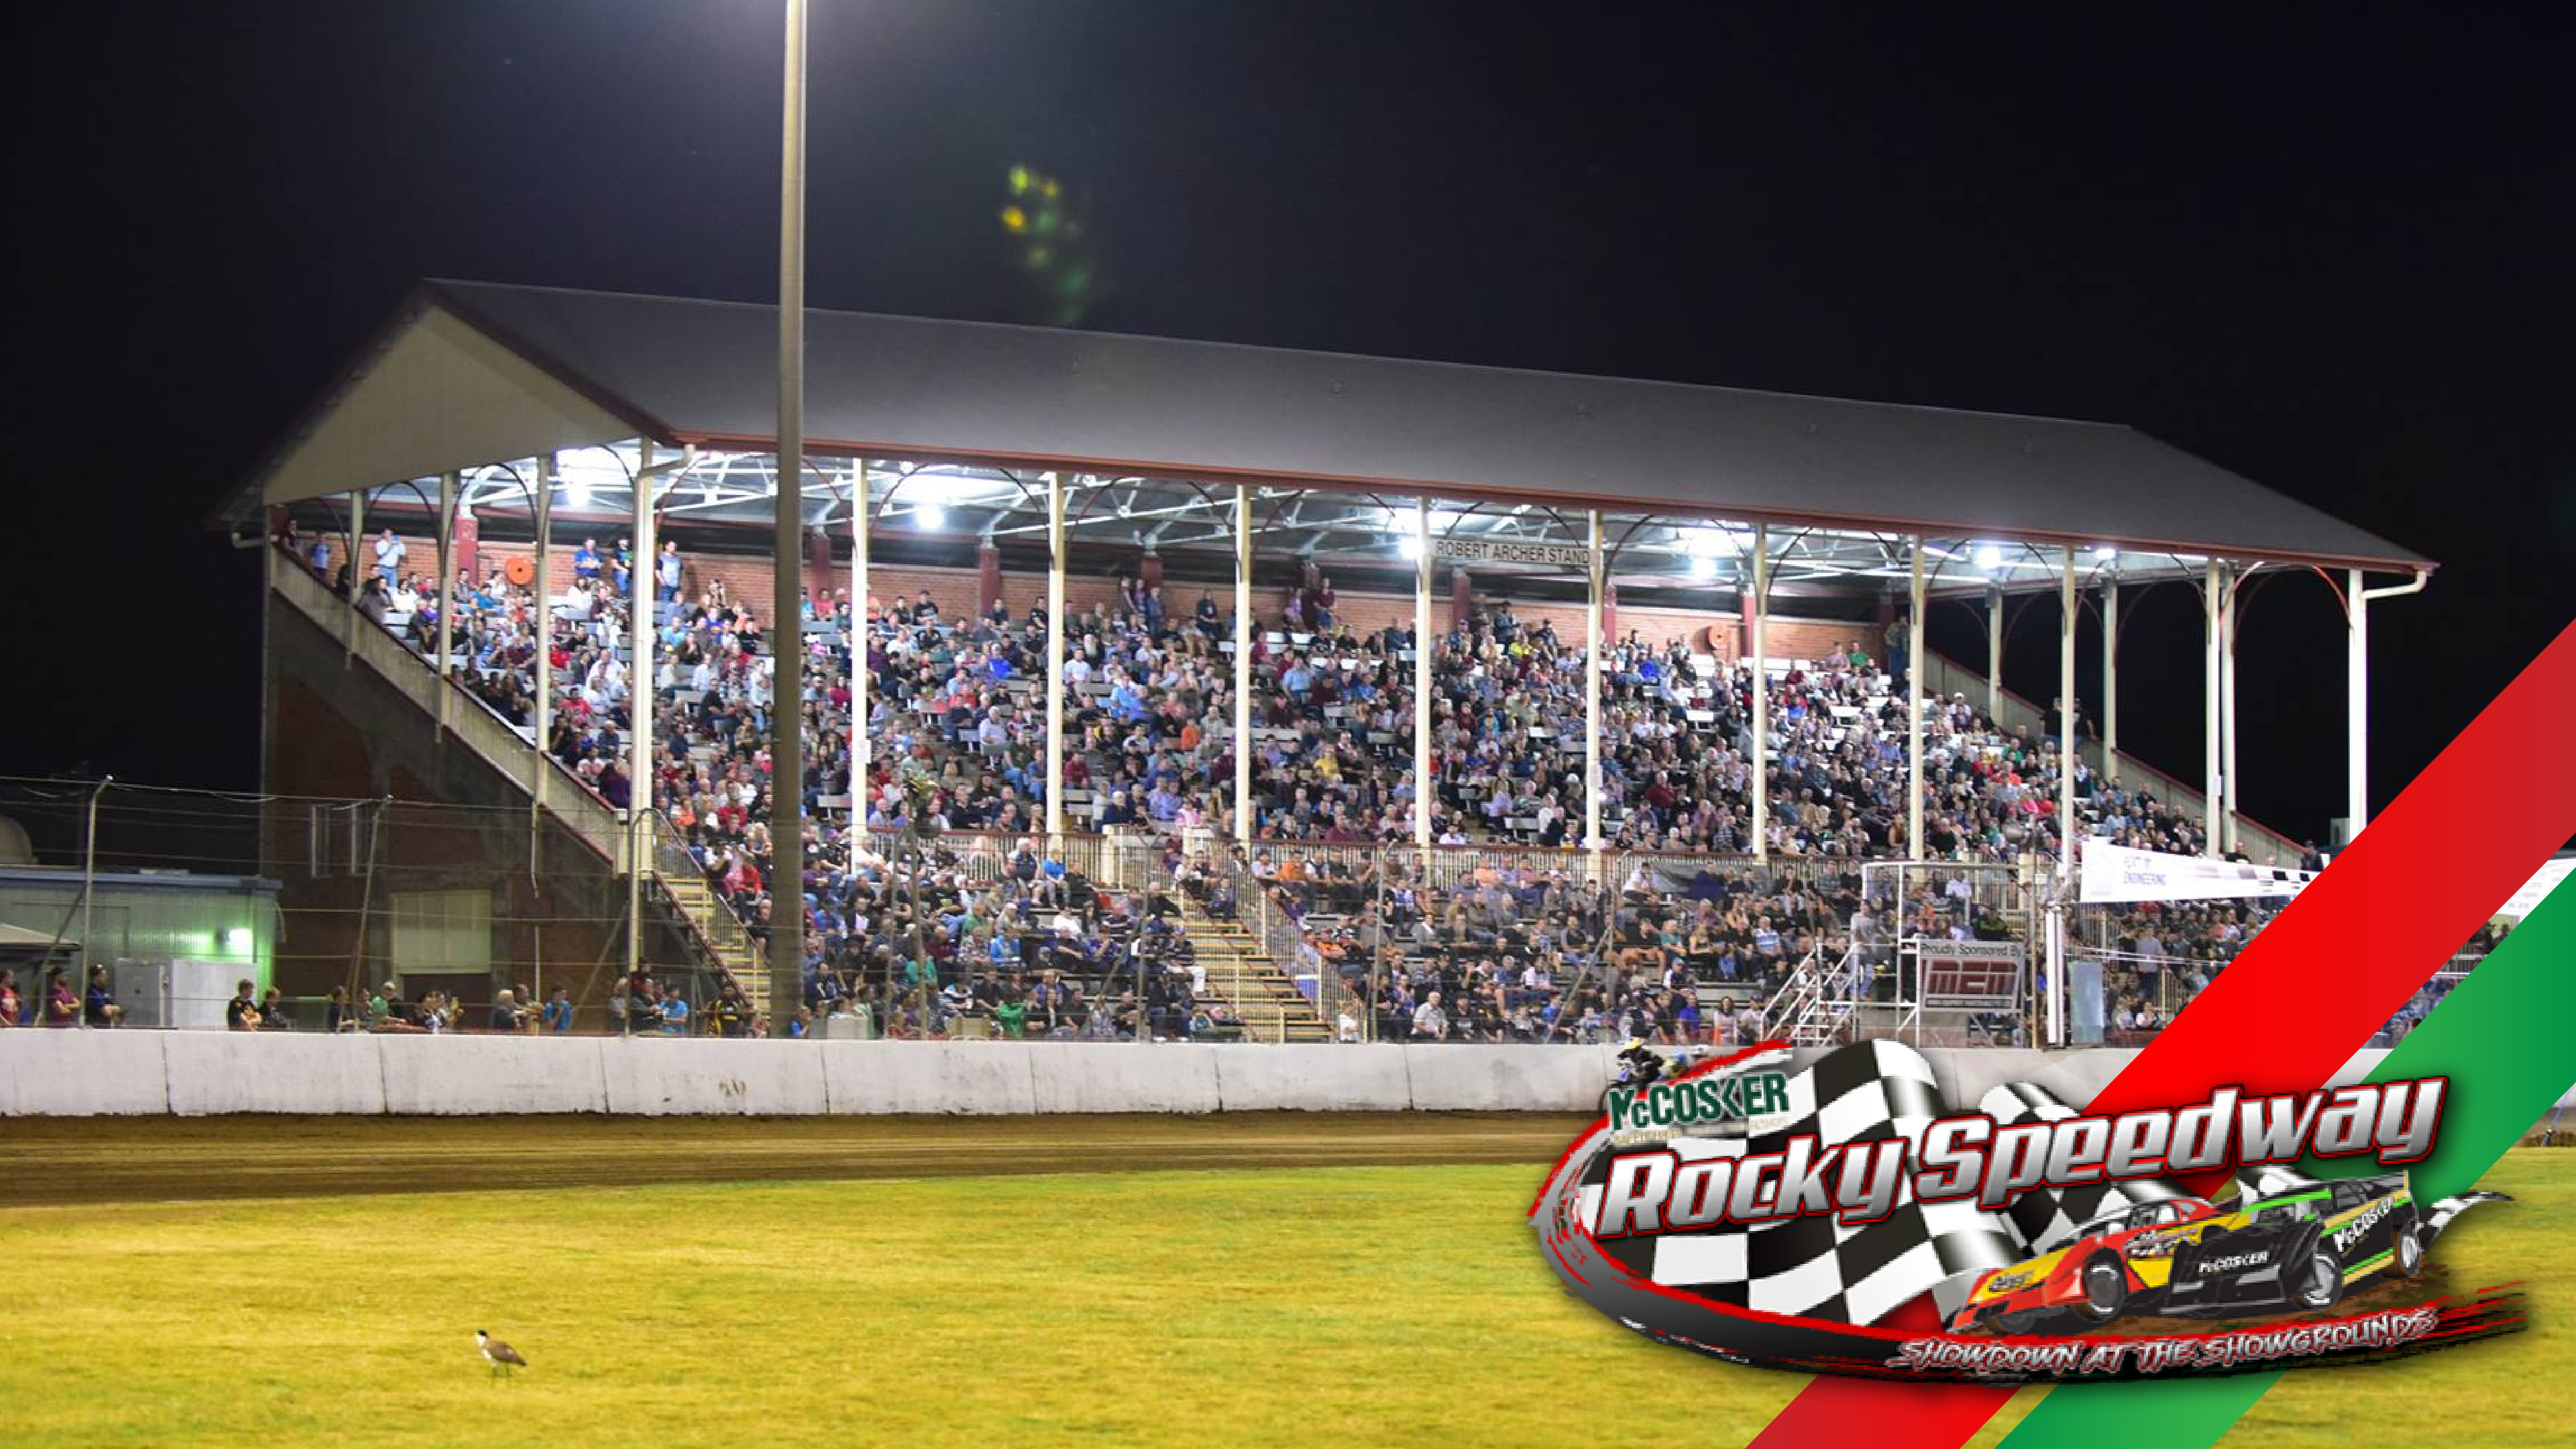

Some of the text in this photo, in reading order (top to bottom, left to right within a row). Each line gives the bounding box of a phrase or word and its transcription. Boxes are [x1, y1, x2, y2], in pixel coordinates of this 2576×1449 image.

[1436, 541, 1589, 564] ROBERT ARCHER STAND
[1921, 943, 1955, 956] Proudly
[1958, 943, 2008, 956] Sponsored
